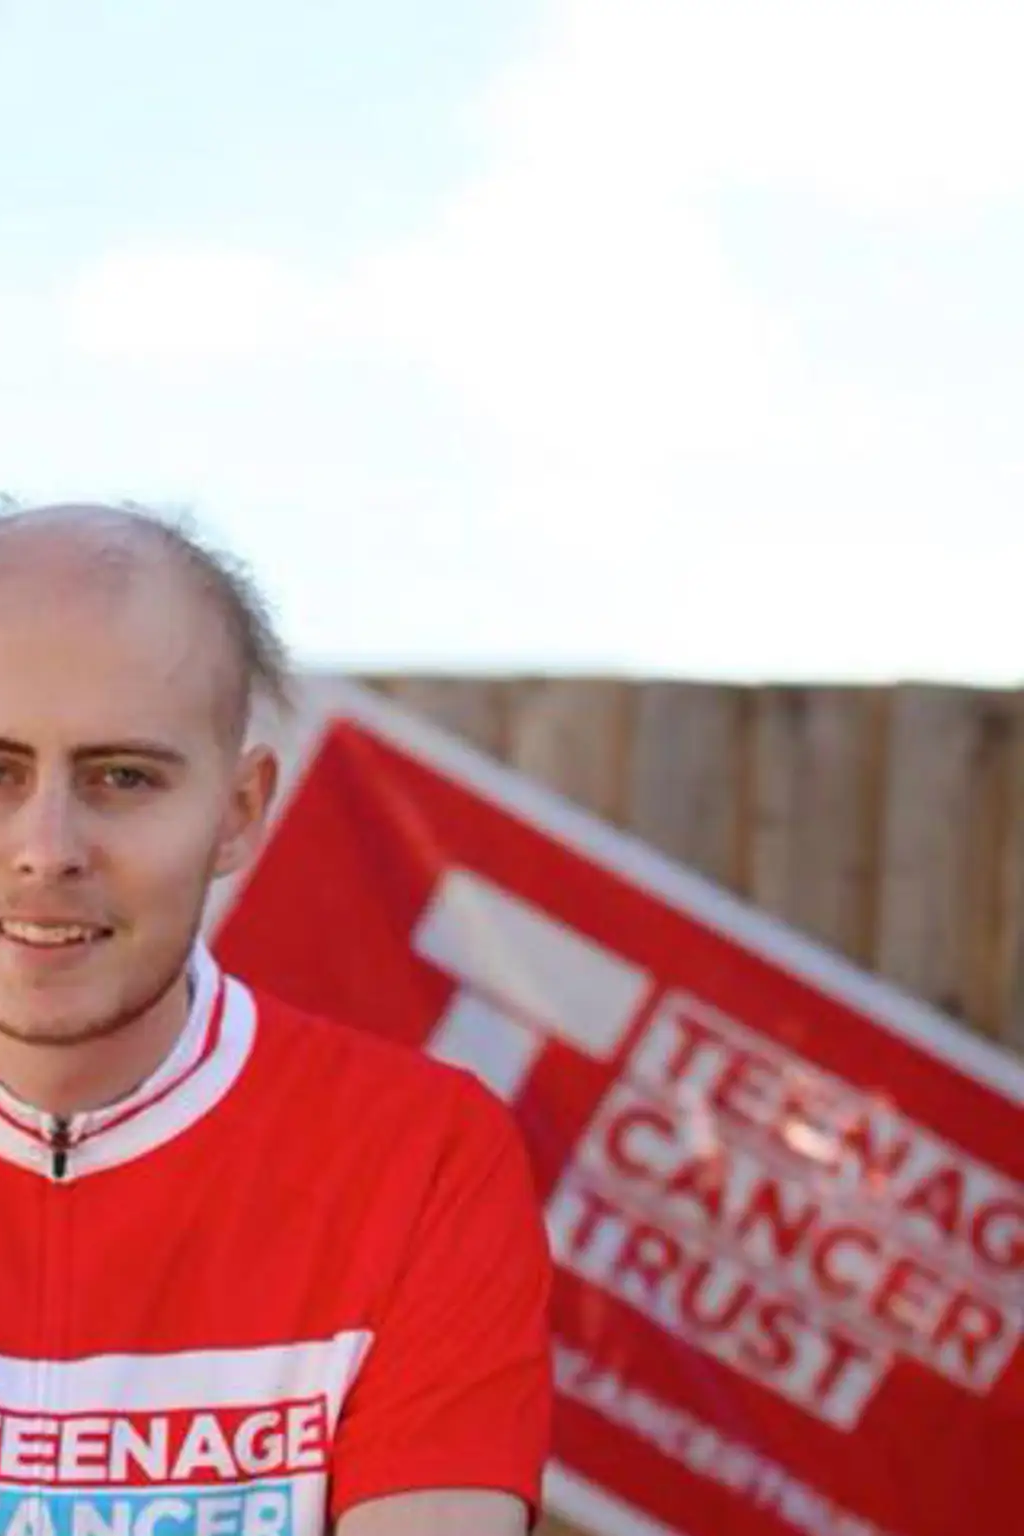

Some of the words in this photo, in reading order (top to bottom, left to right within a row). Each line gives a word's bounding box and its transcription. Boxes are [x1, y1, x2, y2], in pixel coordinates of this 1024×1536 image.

[604, 1106, 1004, 1368] CANCER
[664, 1012, 1023, 1274] TEENAG
[572, 1187, 871, 1396] TRUST
